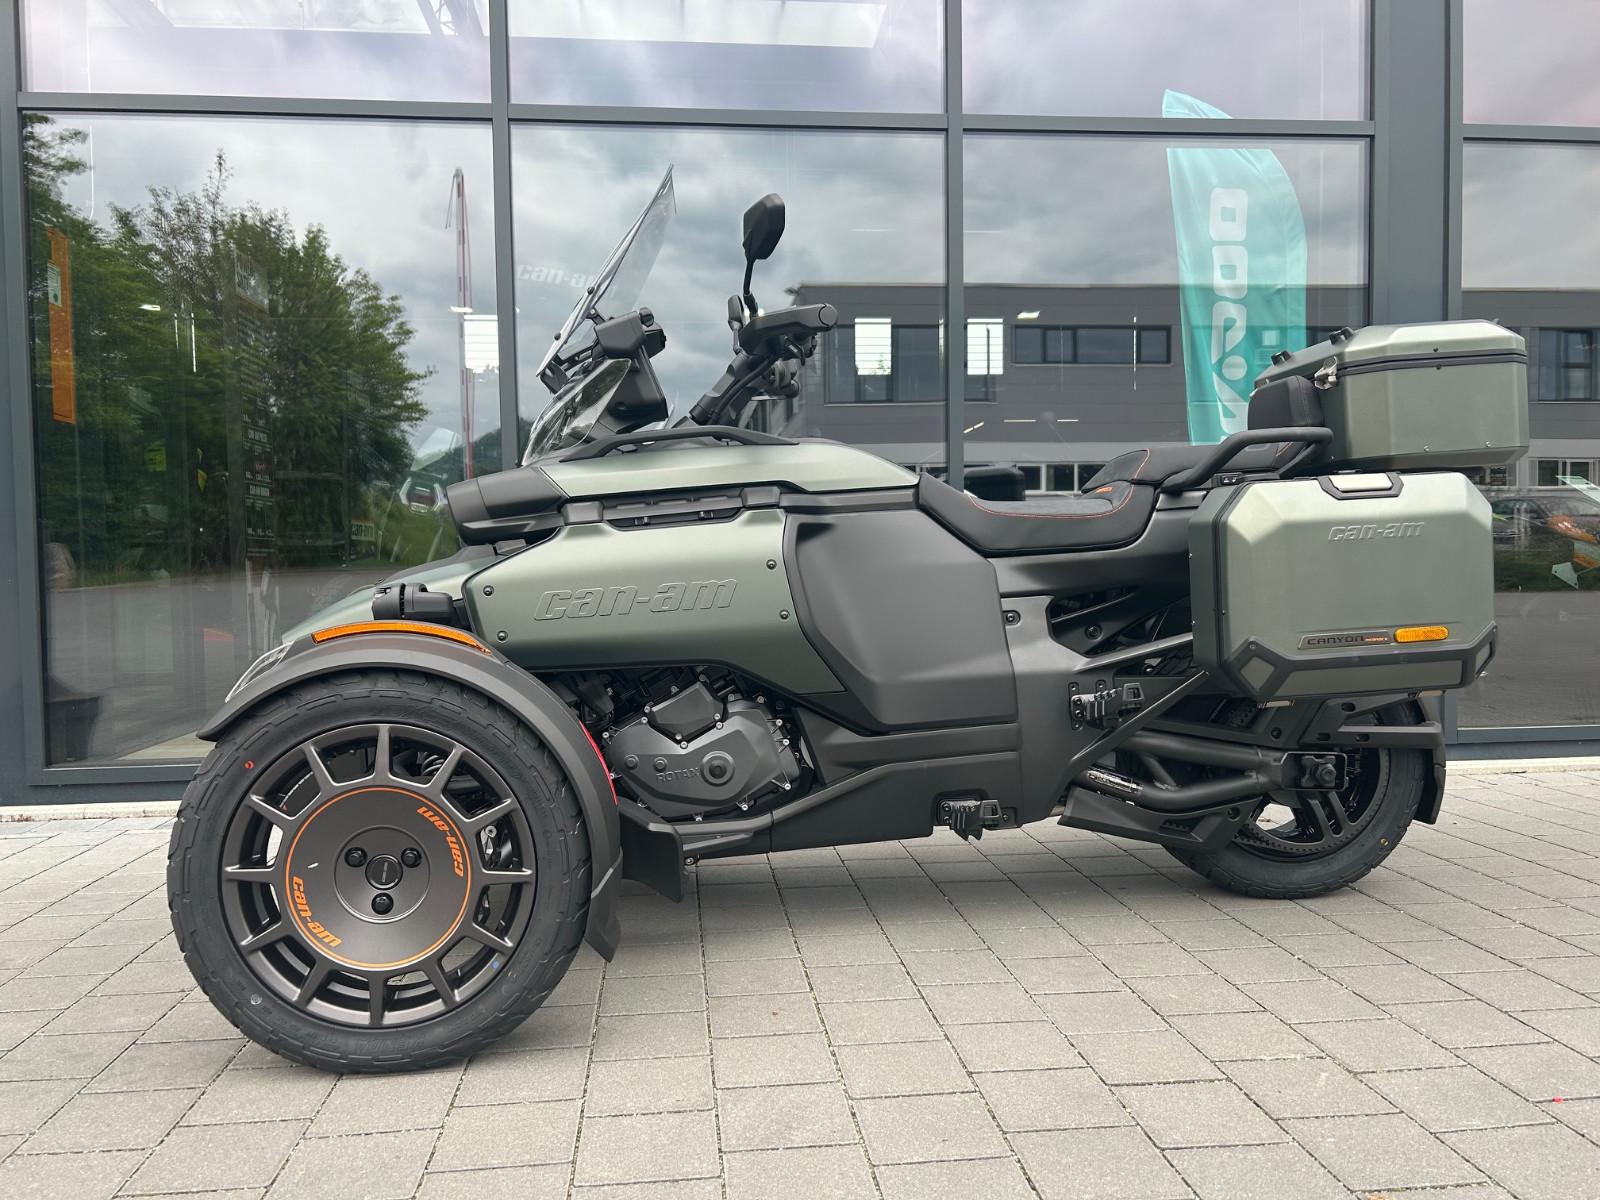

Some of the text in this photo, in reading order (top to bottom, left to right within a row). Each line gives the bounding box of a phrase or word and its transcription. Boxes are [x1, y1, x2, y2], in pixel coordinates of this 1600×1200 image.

[1327, 521, 1425, 541] can-am
[534, 578, 737, 621] can-am
[1307, 635, 1364, 646] CANYON
[416, 806, 464, 877] can-am
[292, 875, 343, 948] can-am
